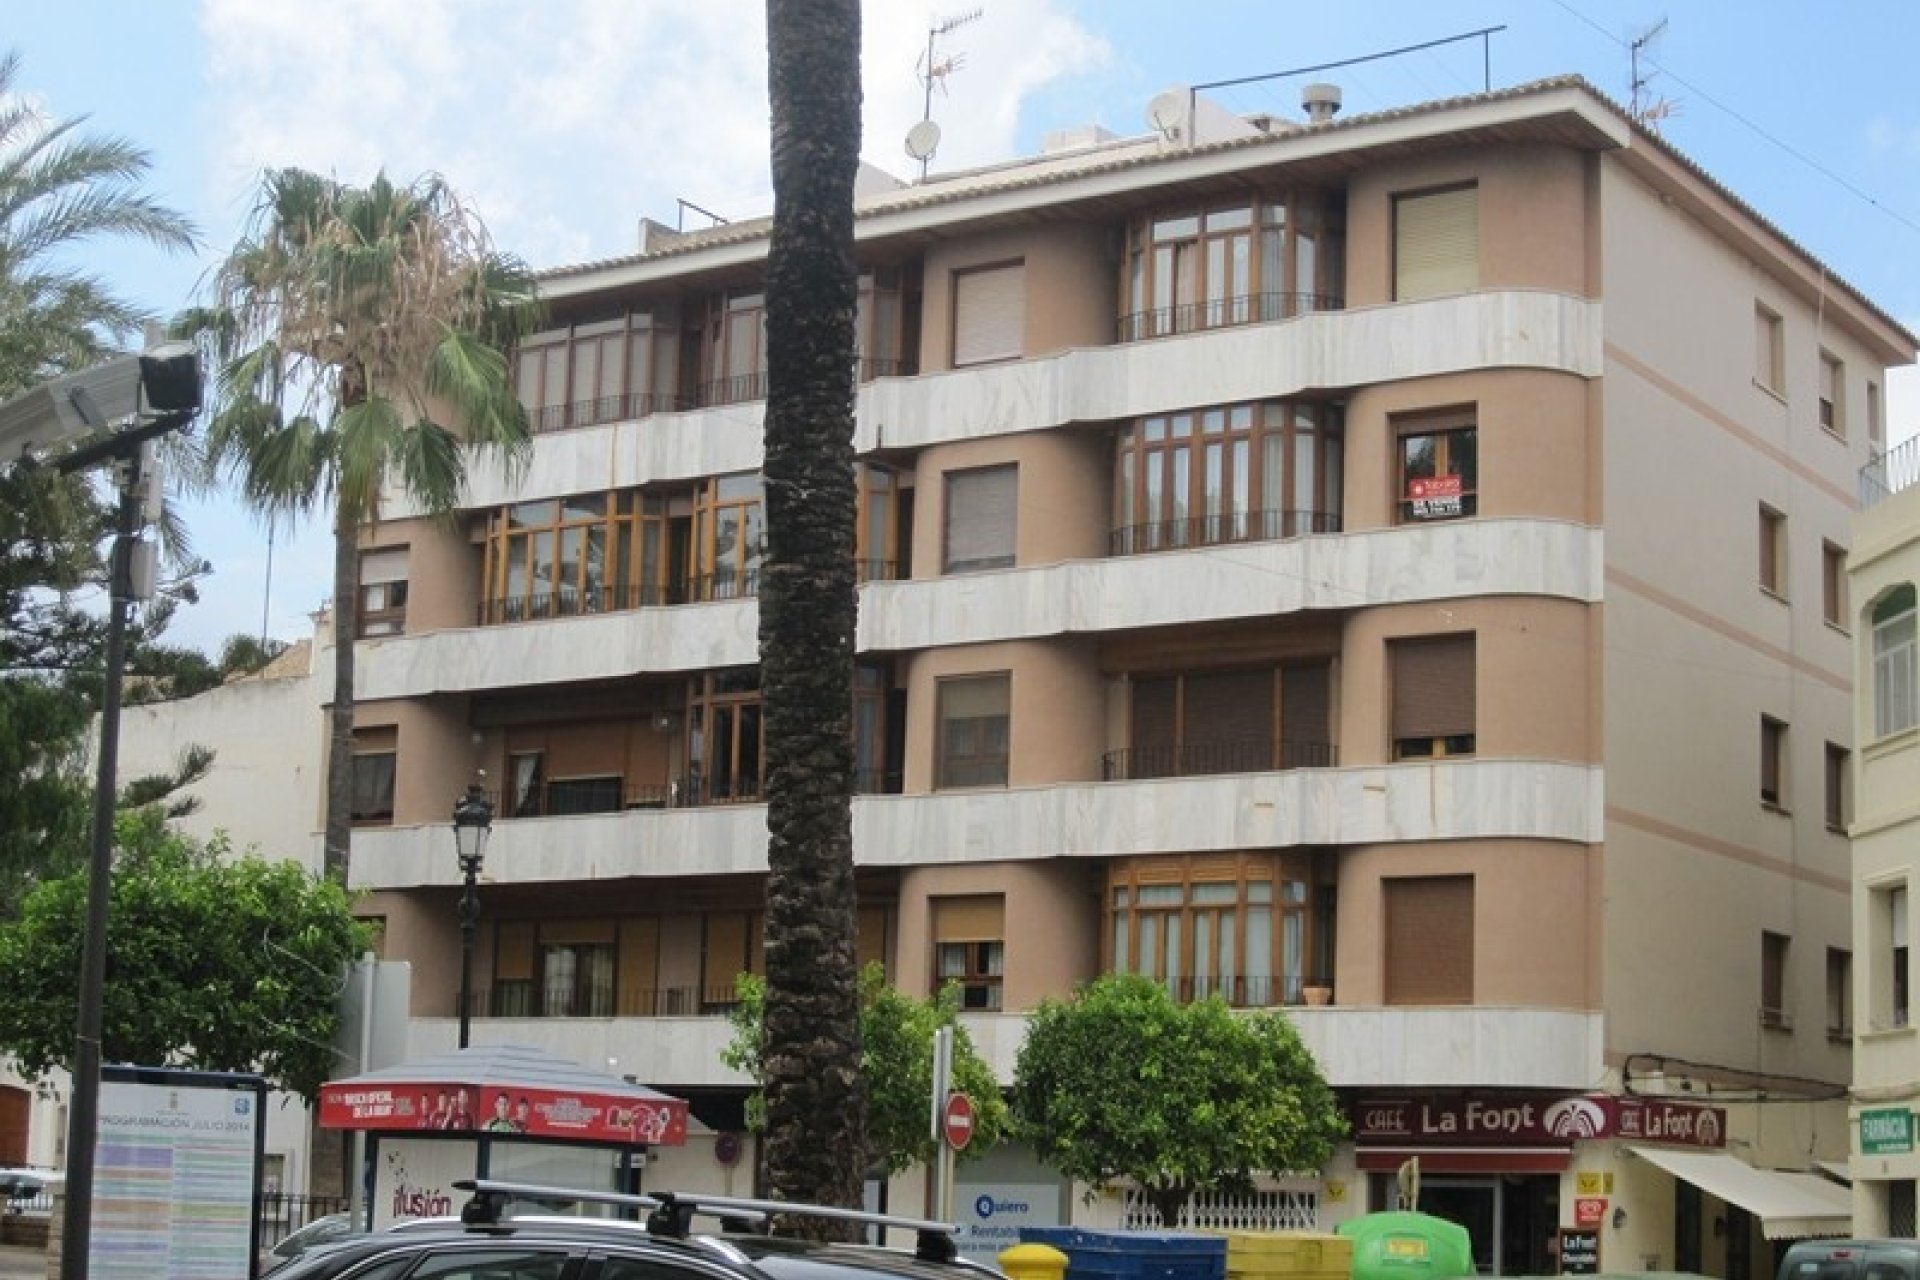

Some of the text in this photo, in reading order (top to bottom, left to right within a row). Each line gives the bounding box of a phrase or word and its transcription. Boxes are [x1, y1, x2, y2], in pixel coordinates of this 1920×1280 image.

[1422, 1104, 1458, 1133] La
[1465, 1101, 1536, 1133] Font
[1645, 1107, 1661, 1136] La
[1663, 1107, 1693, 1139] Font
[975, 1194, 1028, 1218] Quiero
